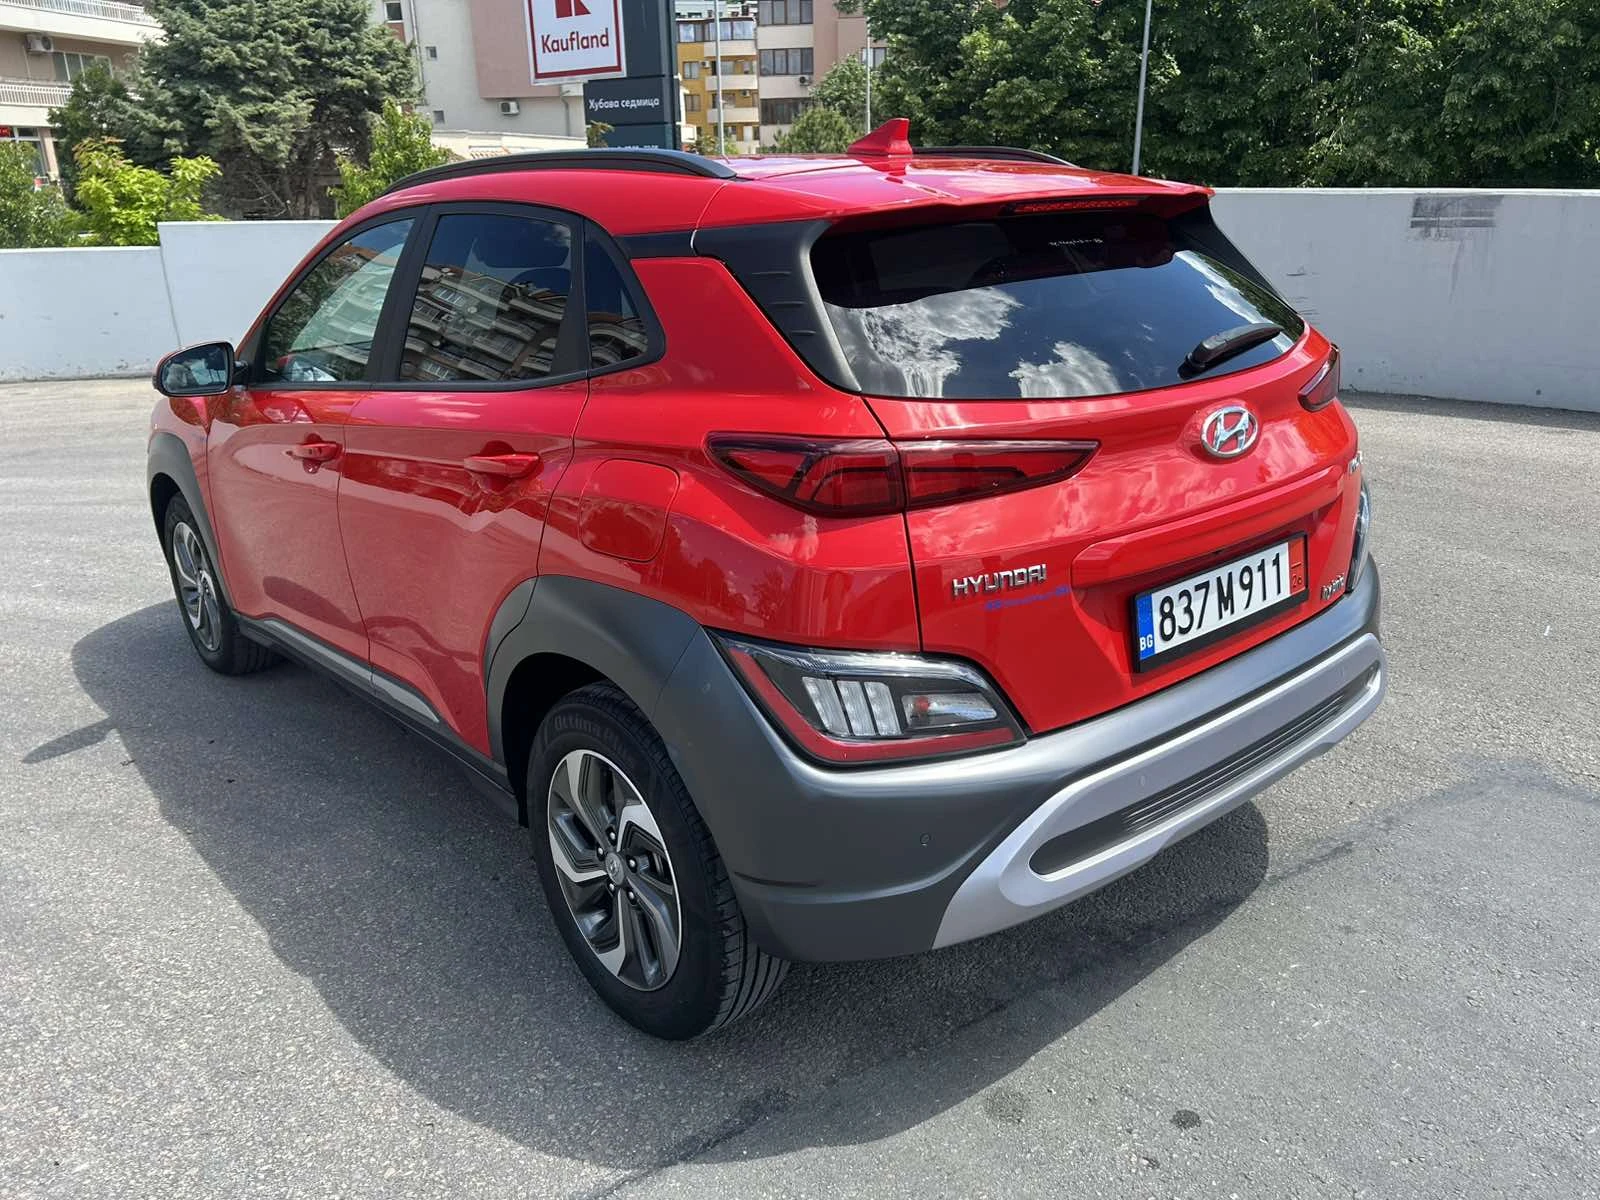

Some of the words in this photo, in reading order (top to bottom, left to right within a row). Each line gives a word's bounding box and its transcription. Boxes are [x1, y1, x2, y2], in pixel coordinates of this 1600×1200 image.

[541, 28, 609, 53] Kaufland
[588, 98, 619, 112] Хубава
[620, 97, 660, 109] седмица
[952, 563, 1047, 596] HYUNDAI
[1159, 552, 1283, 643] 837M911
[1139, 635, 1154, 651] BG
